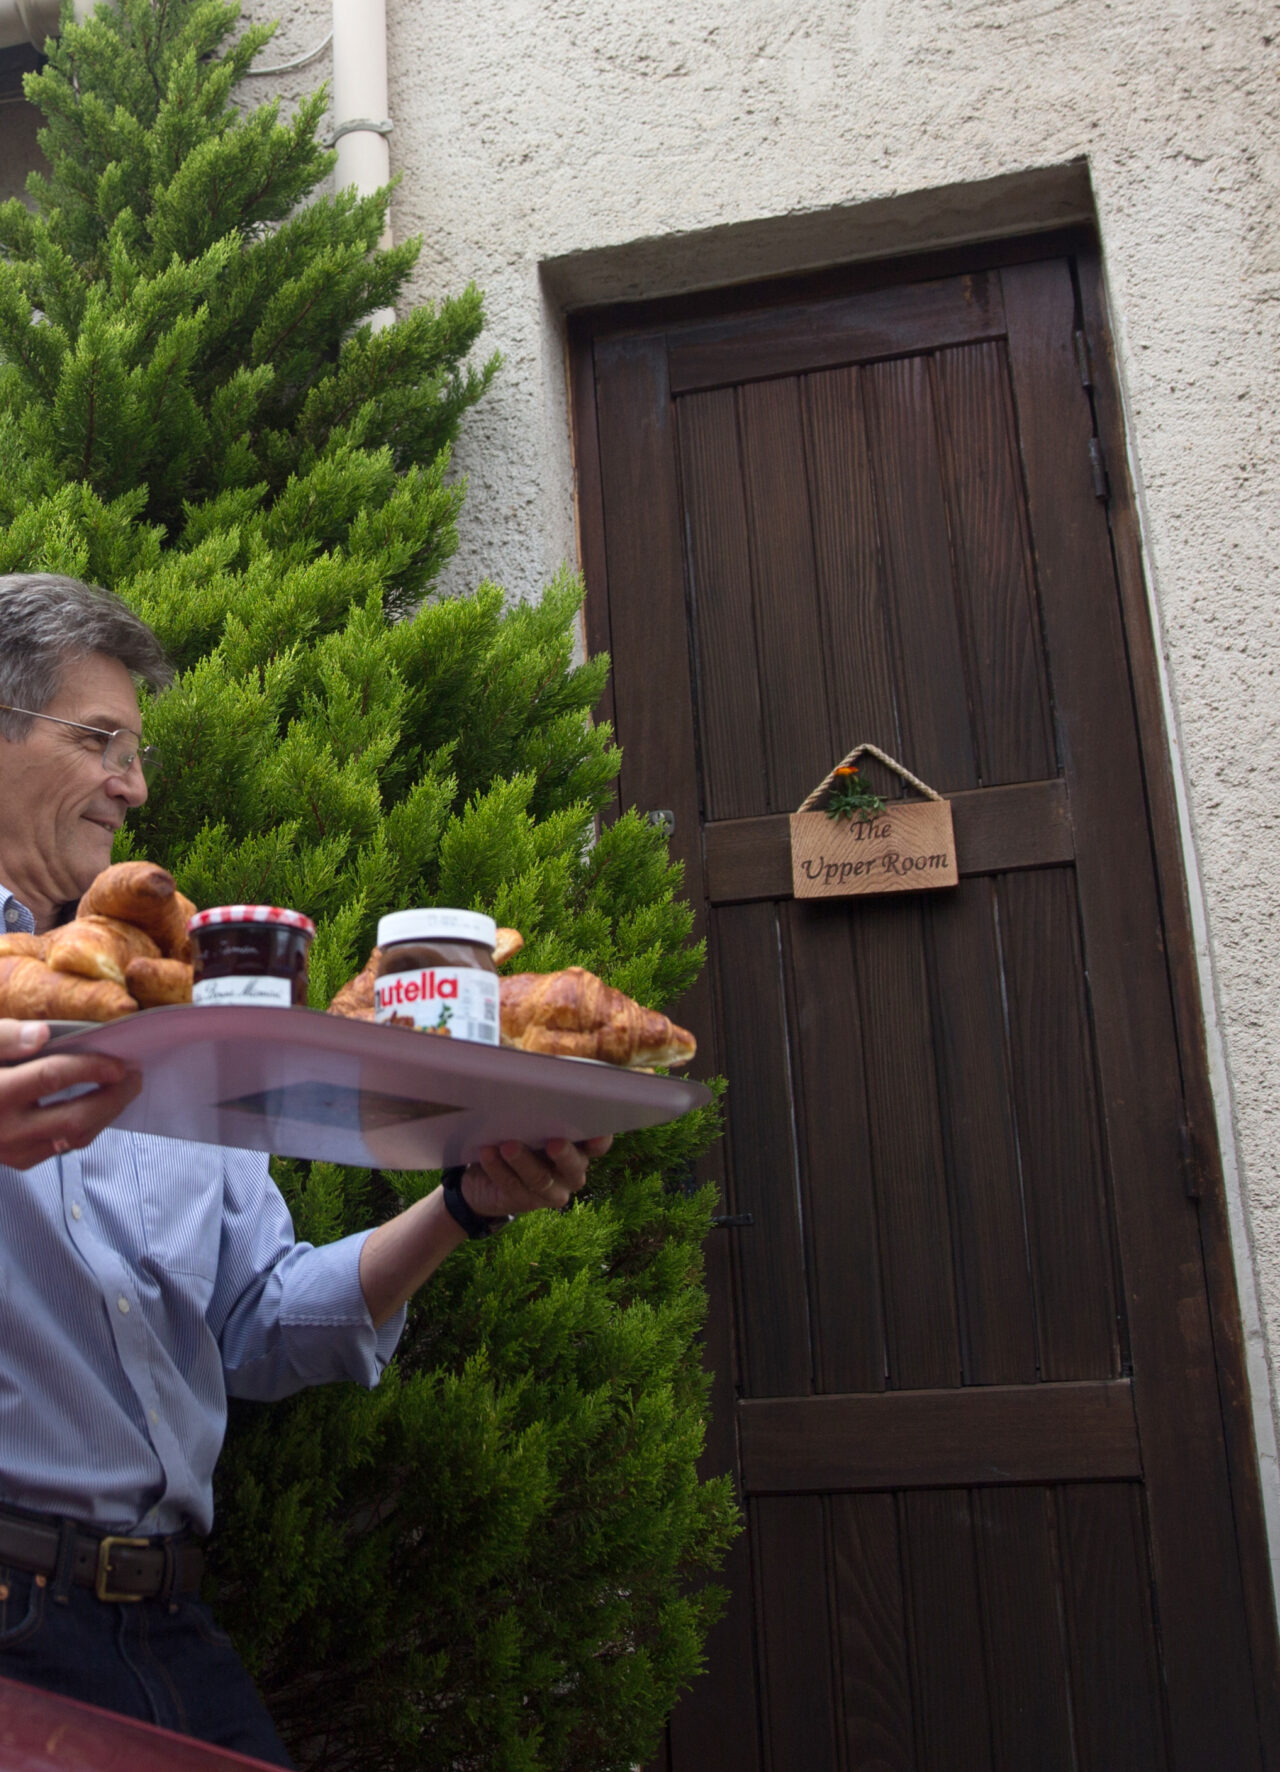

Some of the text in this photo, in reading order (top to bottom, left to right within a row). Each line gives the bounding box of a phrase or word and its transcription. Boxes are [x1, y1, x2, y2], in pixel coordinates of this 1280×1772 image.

[850, 818, 893, 842] The
[801, 852, 949, 885] Upper Room
